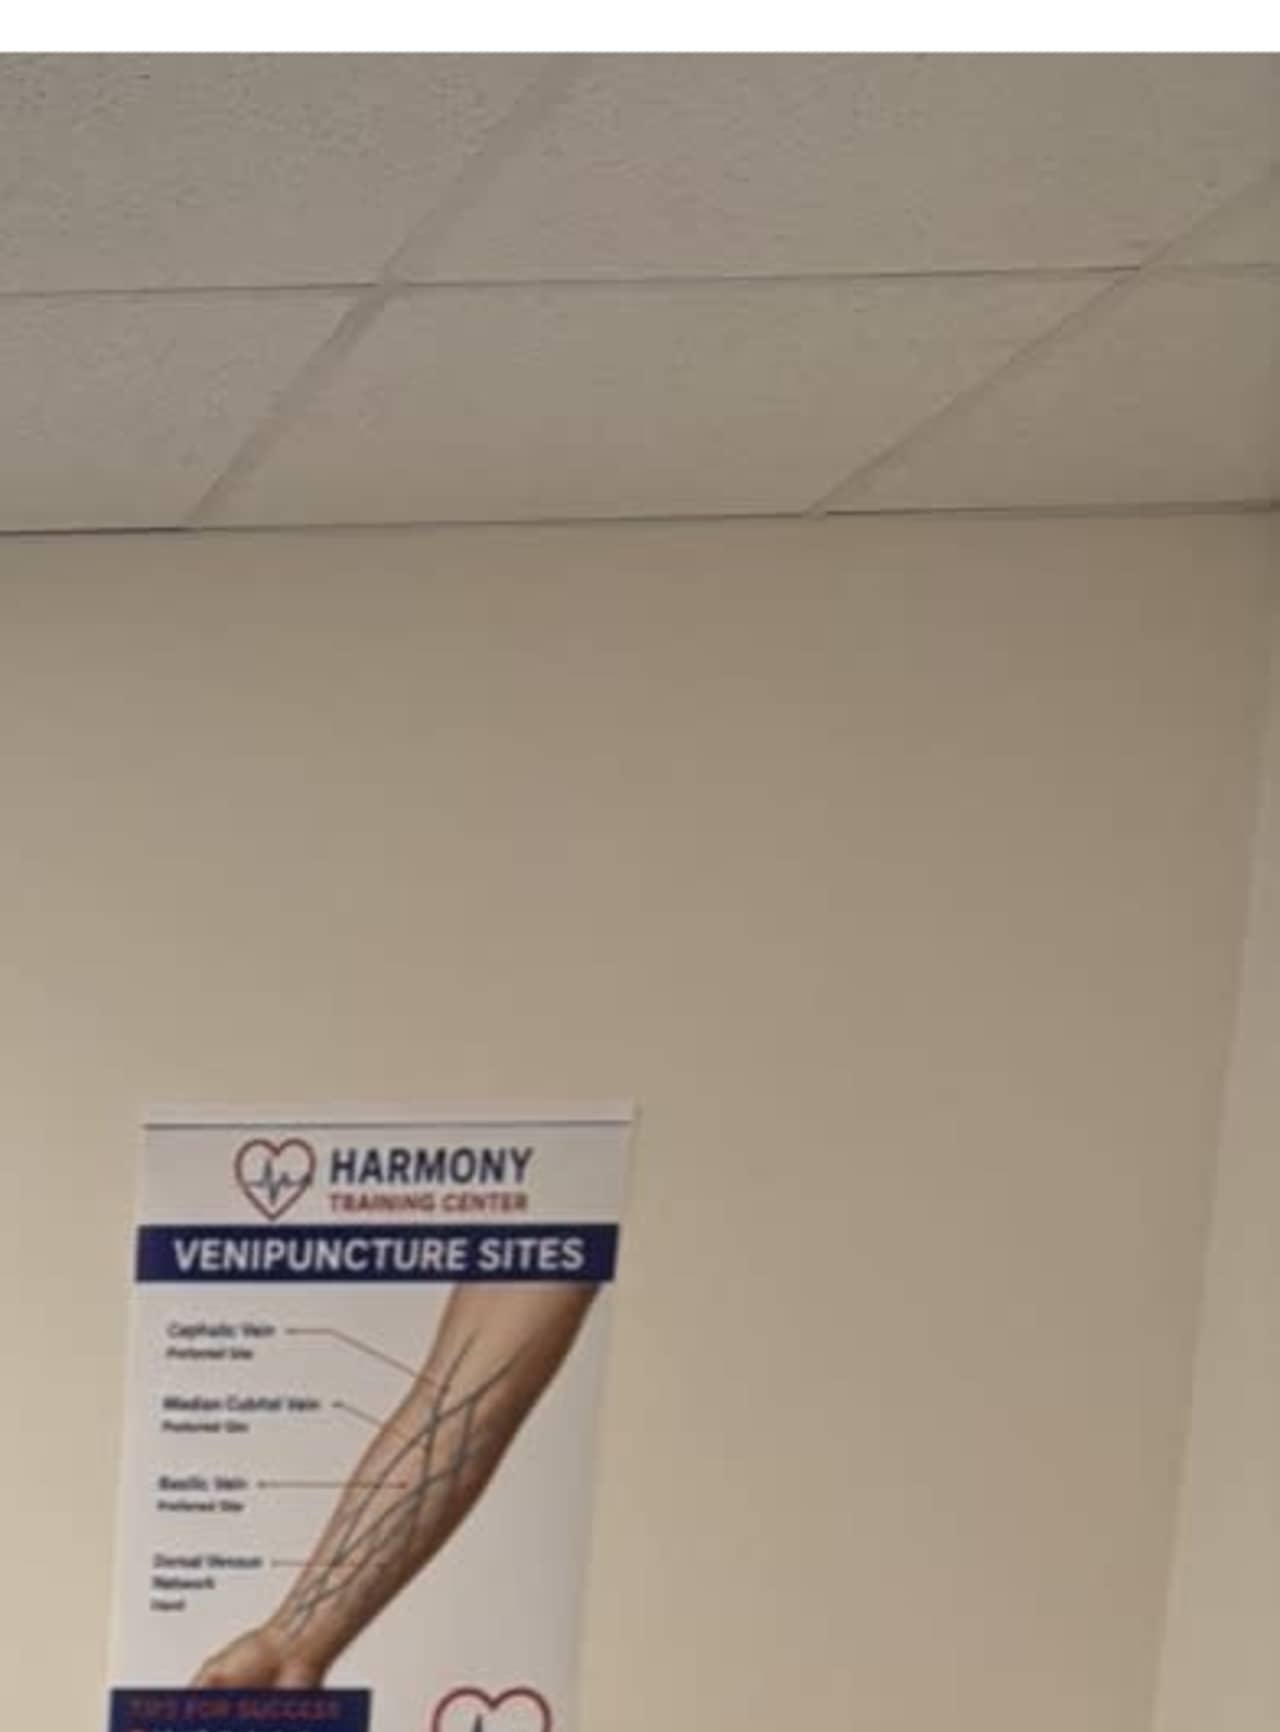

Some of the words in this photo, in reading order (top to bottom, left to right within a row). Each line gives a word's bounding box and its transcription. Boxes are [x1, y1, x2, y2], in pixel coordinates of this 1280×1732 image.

[329, 1147, 534, 1185] HARMONY
[330, 1193, 436, 1213] TRAINING
[442, 1193, 529, 1212] CENTER
[173, 1237, 468, 1273] VENIPUNCTURE
[476, 1237, 585, 1272] SITES
[243, 1322, 276, 1339] Vein
[214, 1475, 248, 1492] Vein
